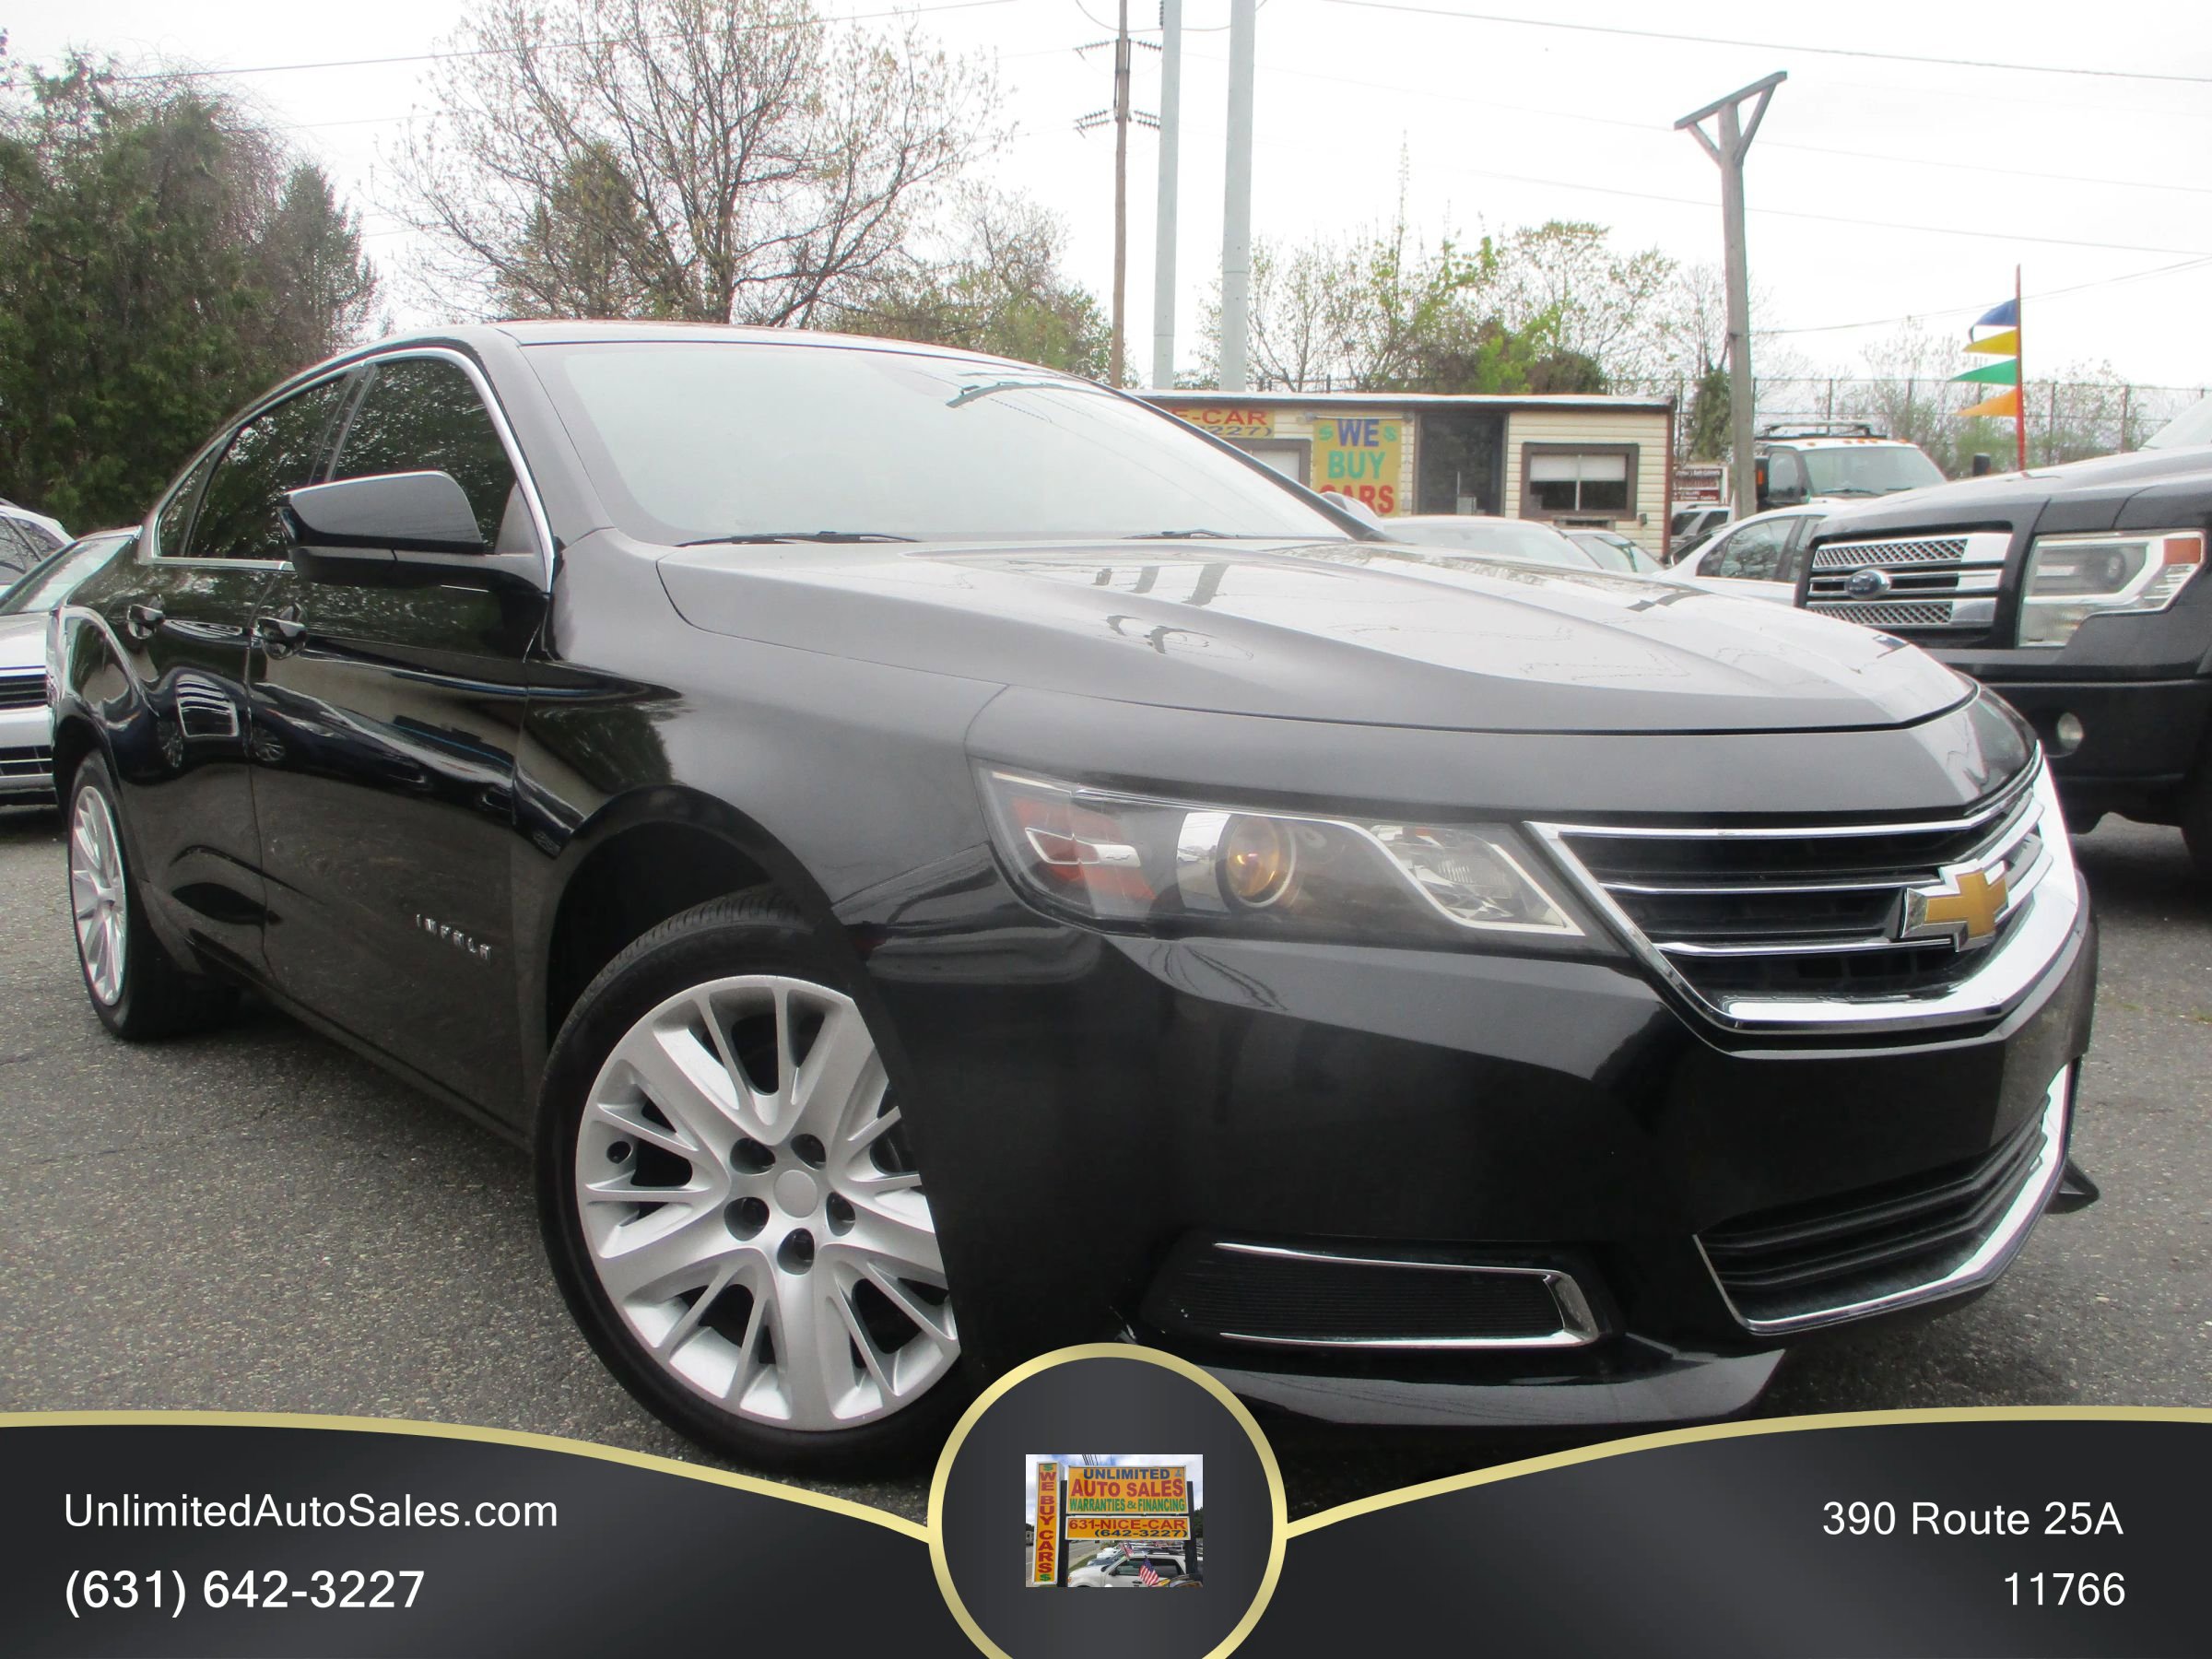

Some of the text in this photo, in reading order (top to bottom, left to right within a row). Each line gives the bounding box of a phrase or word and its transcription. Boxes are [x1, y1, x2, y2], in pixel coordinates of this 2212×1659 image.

[1202, 426, 1272, 437] 227)
[1337, 418, 1380, 447] WE
[1328, 450, 1386, 479] BUY
